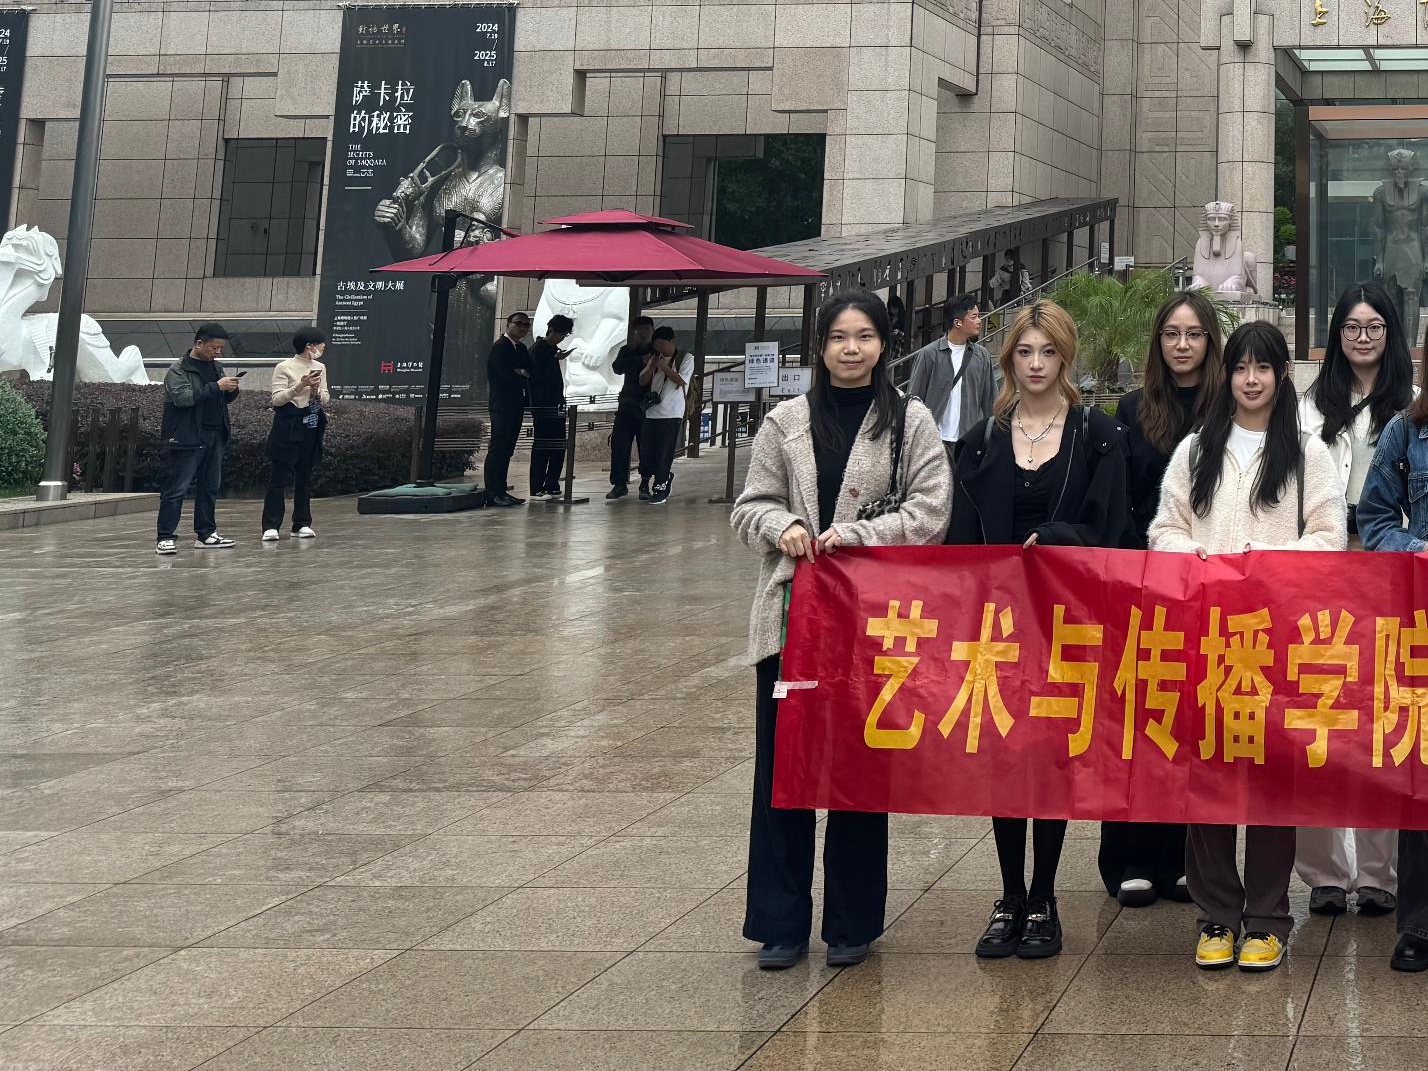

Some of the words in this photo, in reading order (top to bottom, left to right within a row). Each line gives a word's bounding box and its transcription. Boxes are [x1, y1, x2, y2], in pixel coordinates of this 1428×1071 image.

[475, 23, 499, 32] 2024
[473, 50, 497, 60] 2025
[352, 80, 415, 107] 萨卡拉
[349, 106, 414, 138] 的秘密
[357, 159, 387, 167] SAQQARA
[337, 280, 405, 291] 古埃及文明大展
[781, 373, 801, 382] 出口
